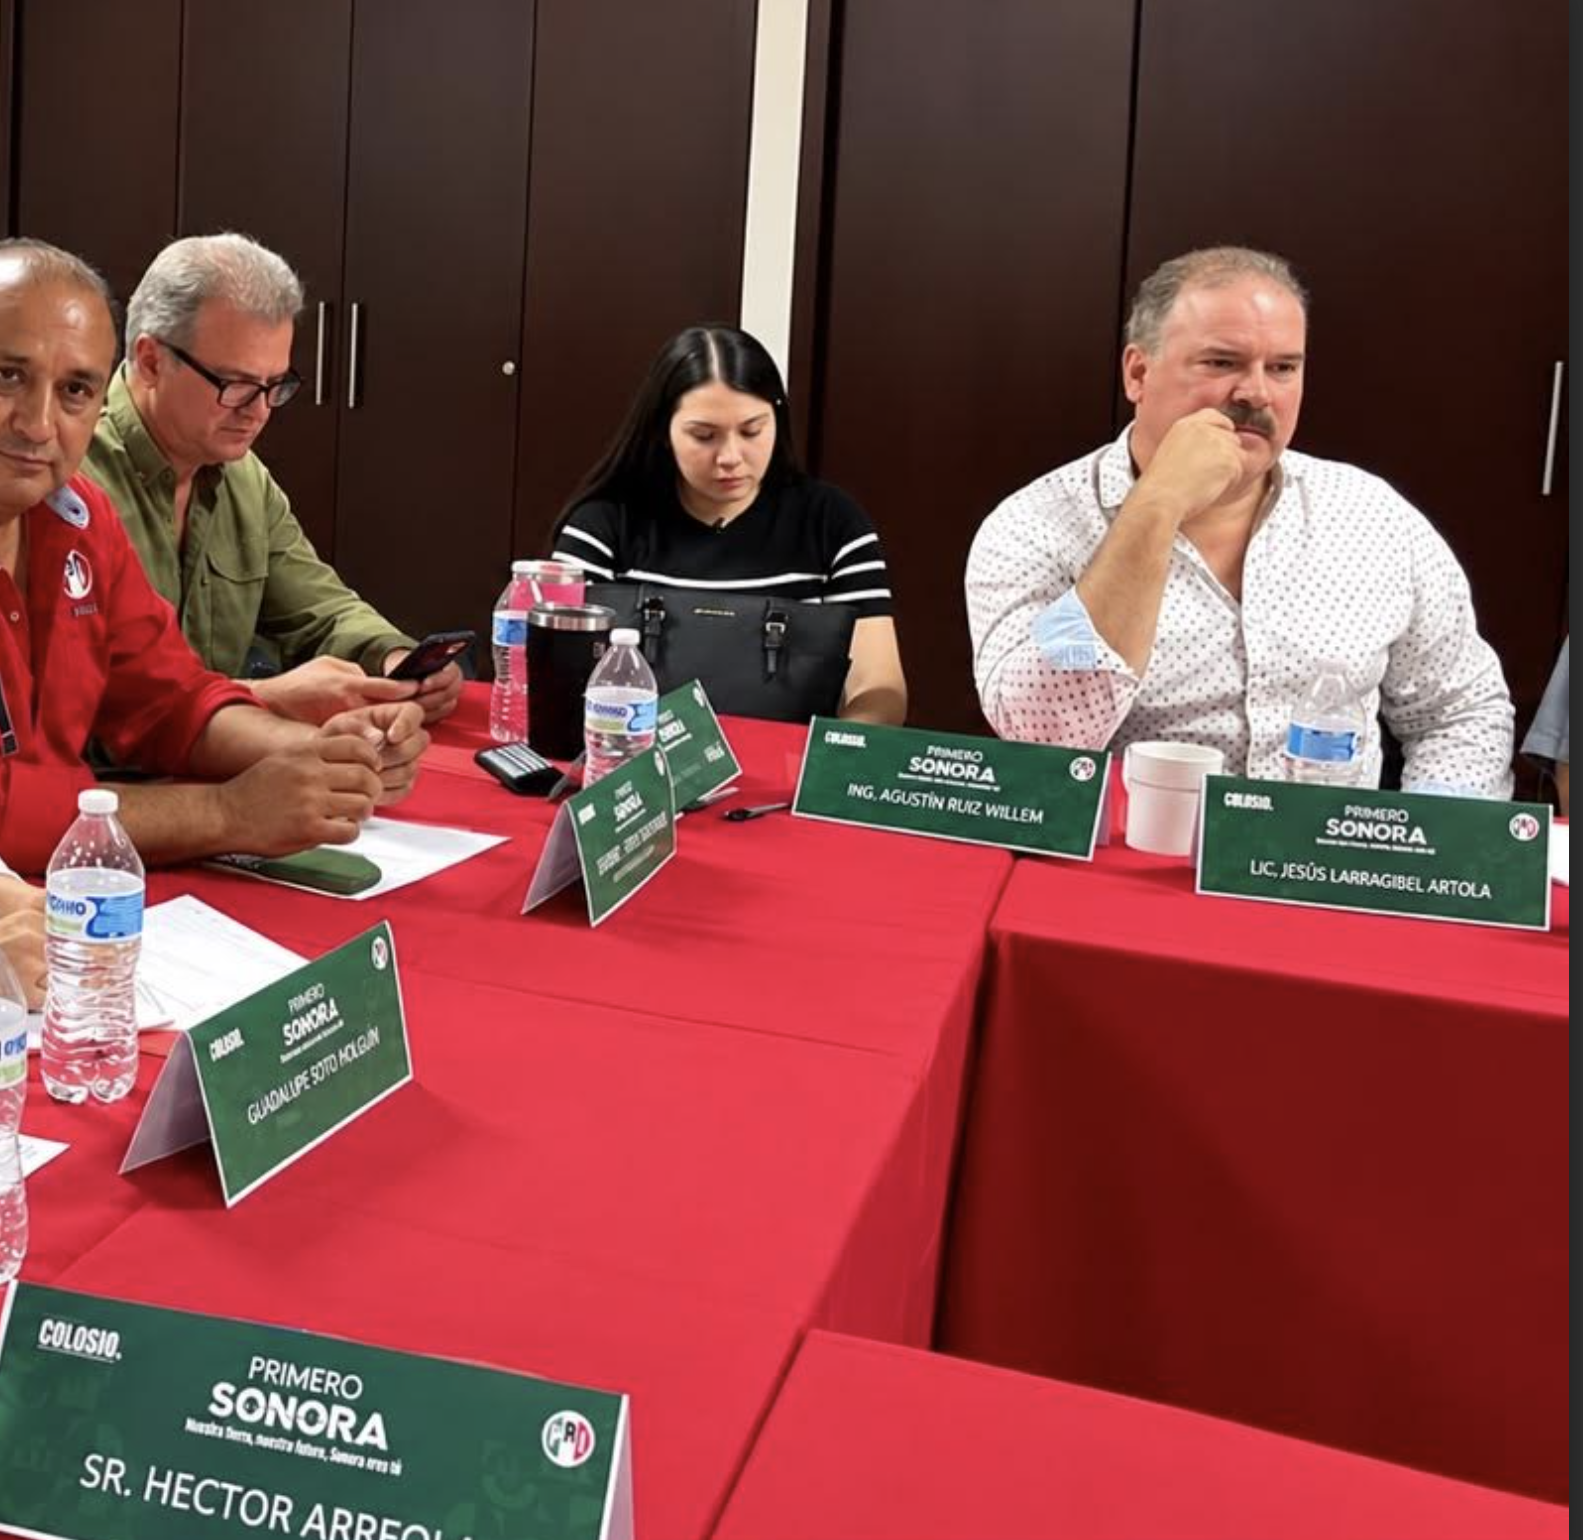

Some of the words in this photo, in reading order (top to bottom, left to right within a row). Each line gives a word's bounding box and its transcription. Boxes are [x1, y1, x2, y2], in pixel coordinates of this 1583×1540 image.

[908, 756, 996, 783] SONORA
[926, 745, 984, 763] PRIMERO
[847, 783, 878, 801] ING.
[879, 789, 945, 810] AGUSTÍN
[947, 797, 981, 816] RUIZ
[985, 804, 1045, 824] WILLEM
[1344, 805, 1409, 823] PRIMERO
[1326, 818, 1427, 845] SONORA
[1280, 861, 1327, 882] JESÚS
[1330, 869, 1424, 893] LARRAGIBEL
[1427, 878, 1492, 900] ARTOLA
[282, 998, 339, 1047] SONORA
[247, 1070, 311, 1125] GUADALUPE
[310, 1053, 339, 1086] SOTO
[248, 1356, 363, 1400] PRIMERO
[208, 1381, 389, 1451] SONORA
[329, 1447, 365, 1468] Sonora
[79, 1453, 132, 1497] SR.
[143, 1465, 294, 1534] HECTOR
